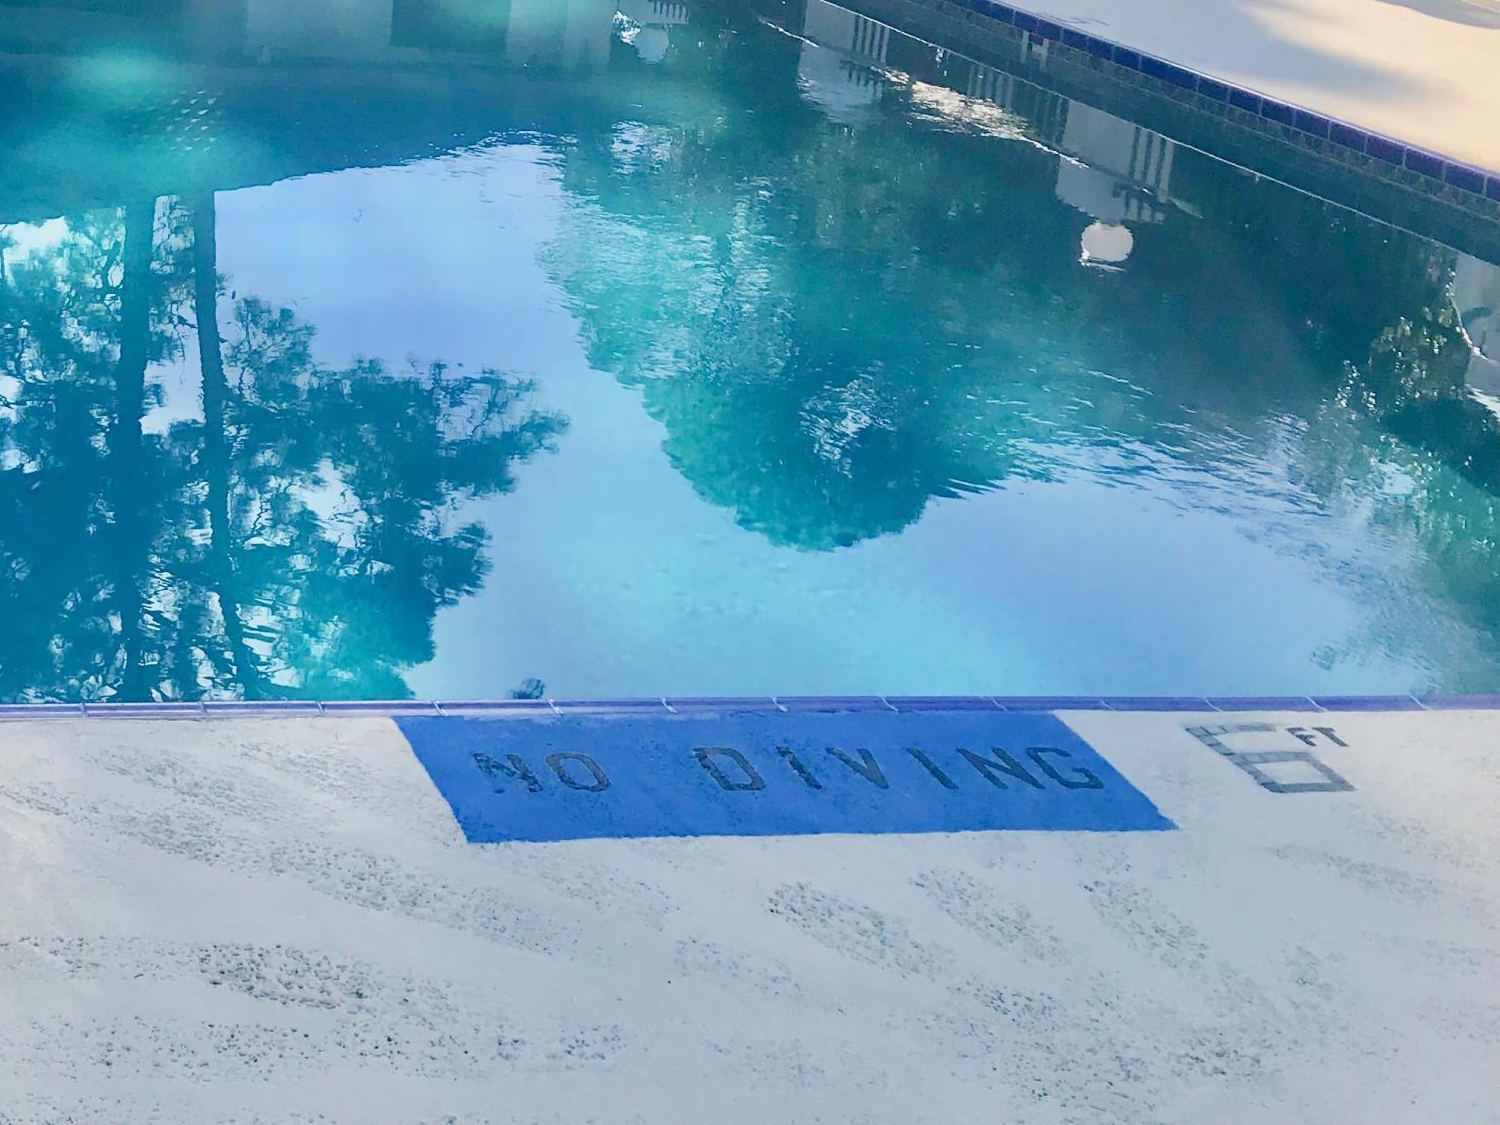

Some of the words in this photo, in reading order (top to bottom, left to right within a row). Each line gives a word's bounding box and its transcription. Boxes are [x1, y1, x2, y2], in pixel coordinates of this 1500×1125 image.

[471, 752, 611, 793] NO
[693, 746, 1104, 791] DIVING
[1182, 723, 1358, 794] 6
[1284, 726, 1350, 747] FT
